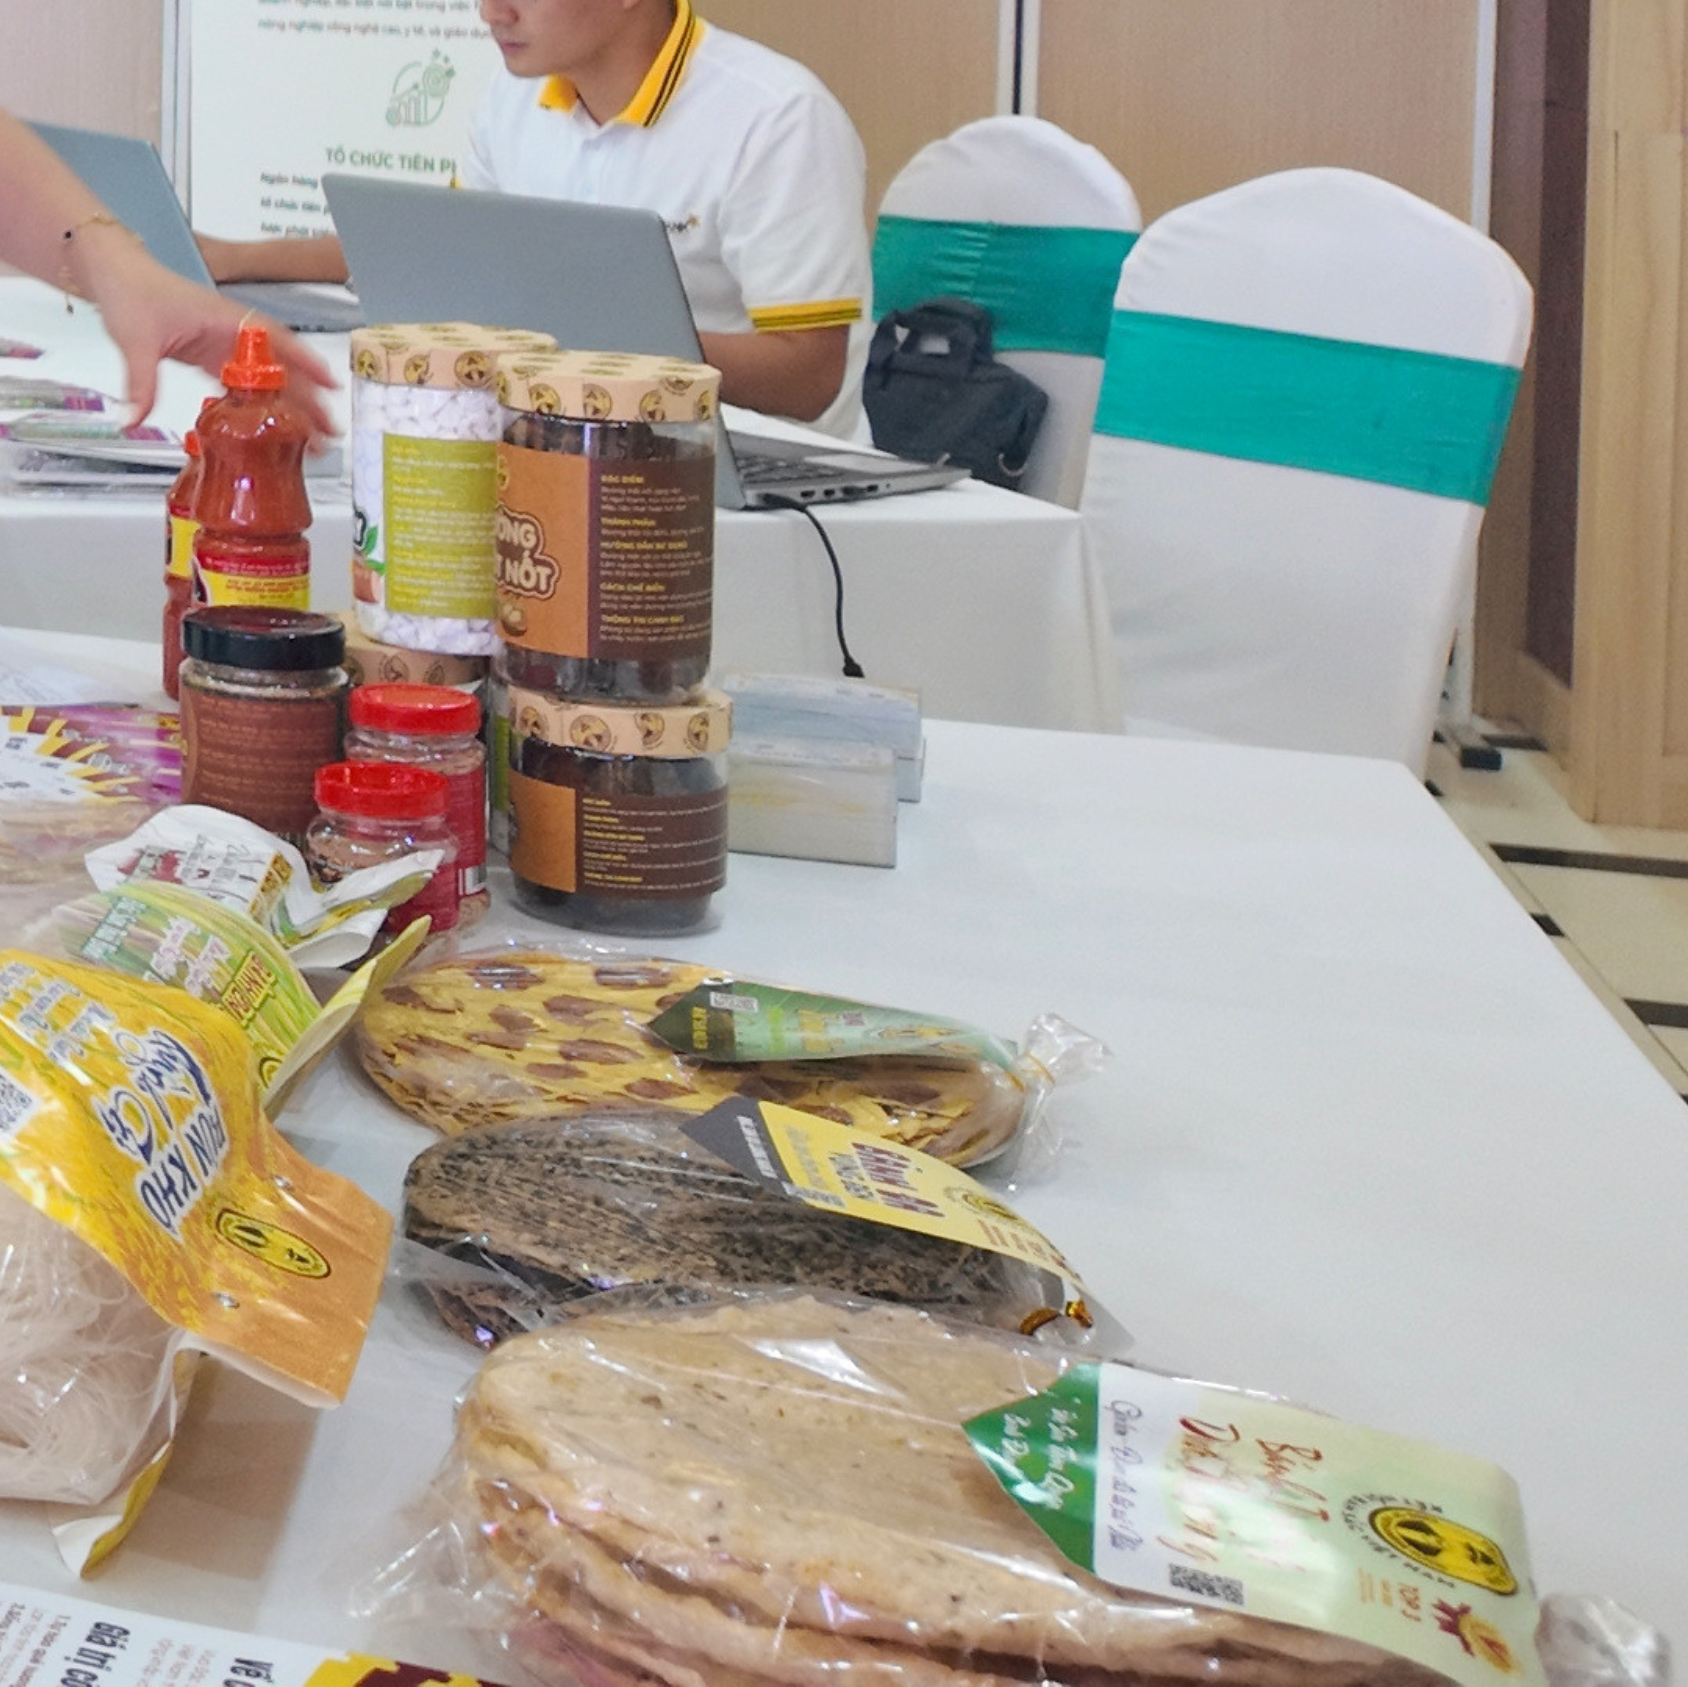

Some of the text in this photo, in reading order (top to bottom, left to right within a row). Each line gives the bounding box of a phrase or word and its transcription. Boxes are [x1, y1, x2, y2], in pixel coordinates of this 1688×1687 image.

[326, 144, 345, 162] TỔ
[349, 149, 394, 169] CHỨC
[85, 1621, 130, 1650] Giá
[64, 1646, 116, 1672] trị
